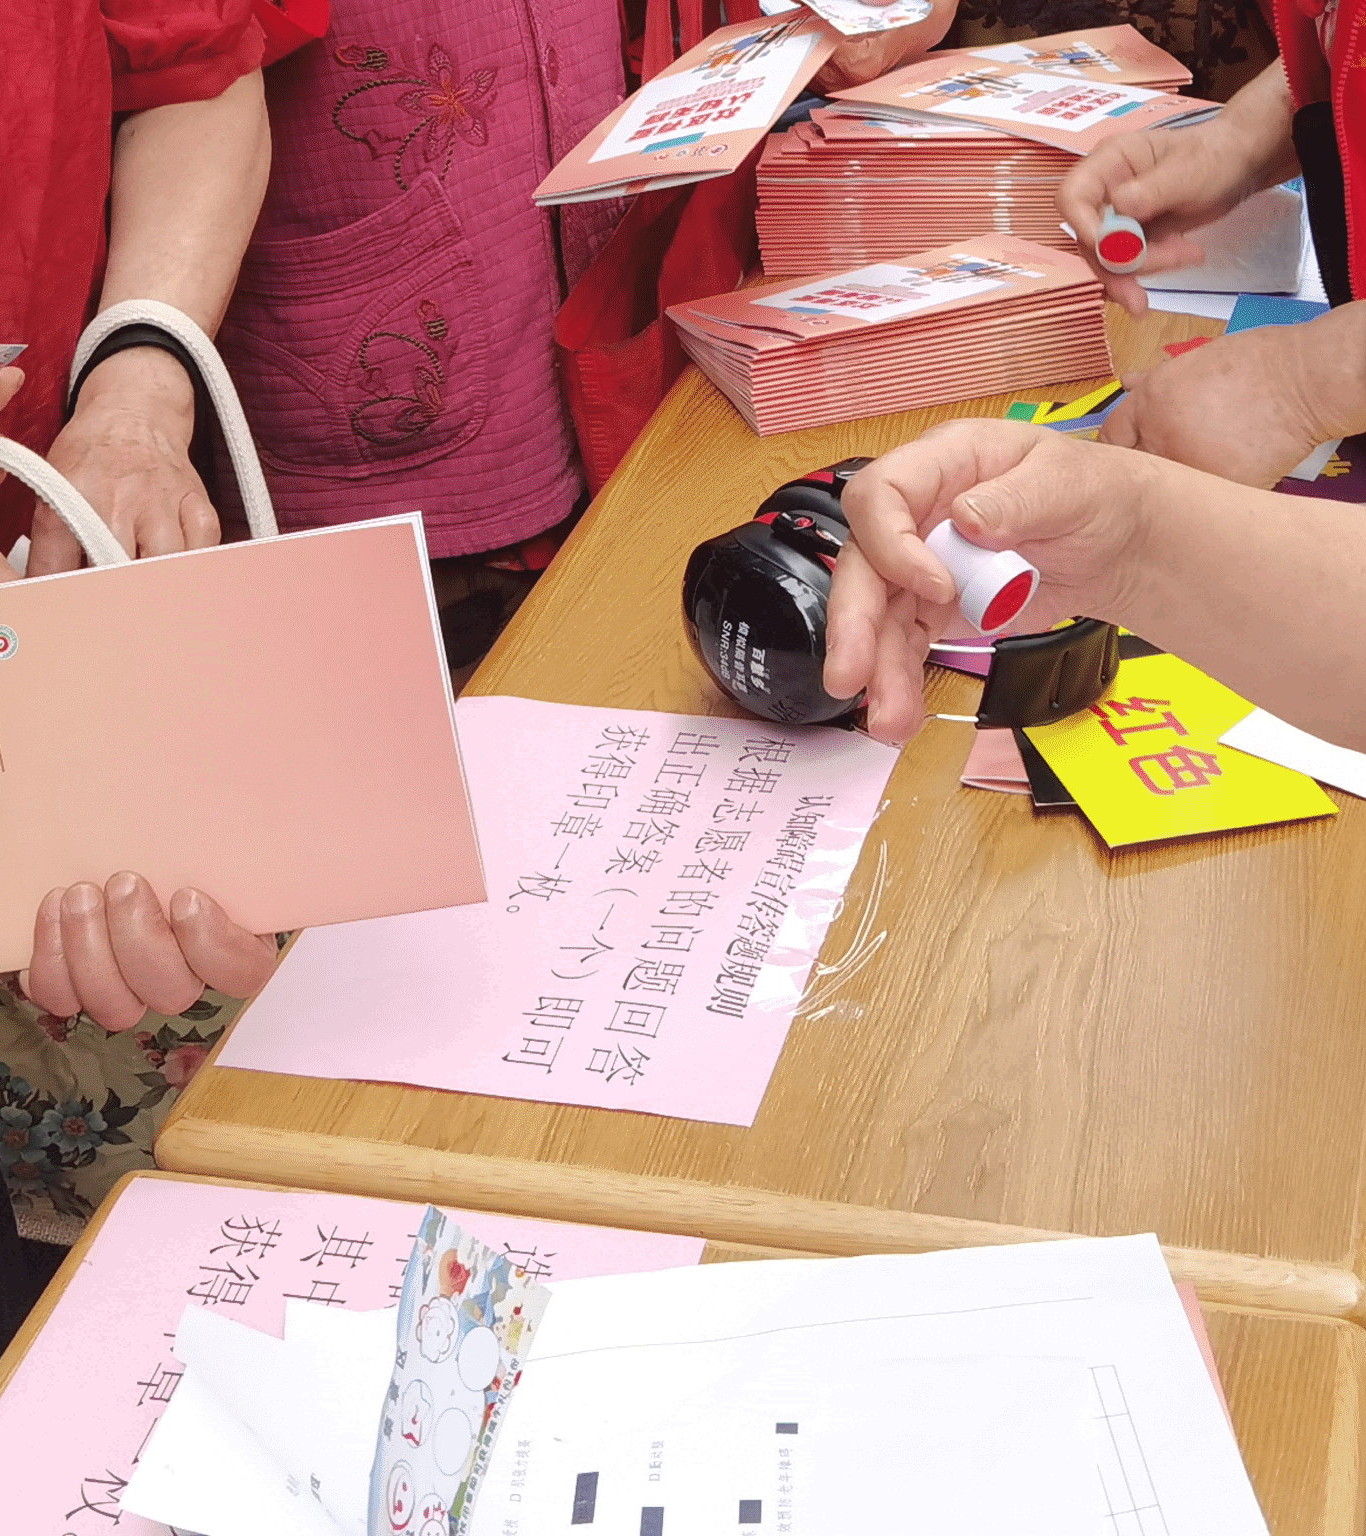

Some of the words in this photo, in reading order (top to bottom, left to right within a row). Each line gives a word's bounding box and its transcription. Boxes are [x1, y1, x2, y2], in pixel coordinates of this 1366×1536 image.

[505, 724, 651, 915] 获得印章一枚。
[1089, 696, 1223, 796] 红色
[584, 734, 795, 1087] 根据志愿者的问题回答
[705, 793, 835, 1019] 认知障碍宣传答题规则
